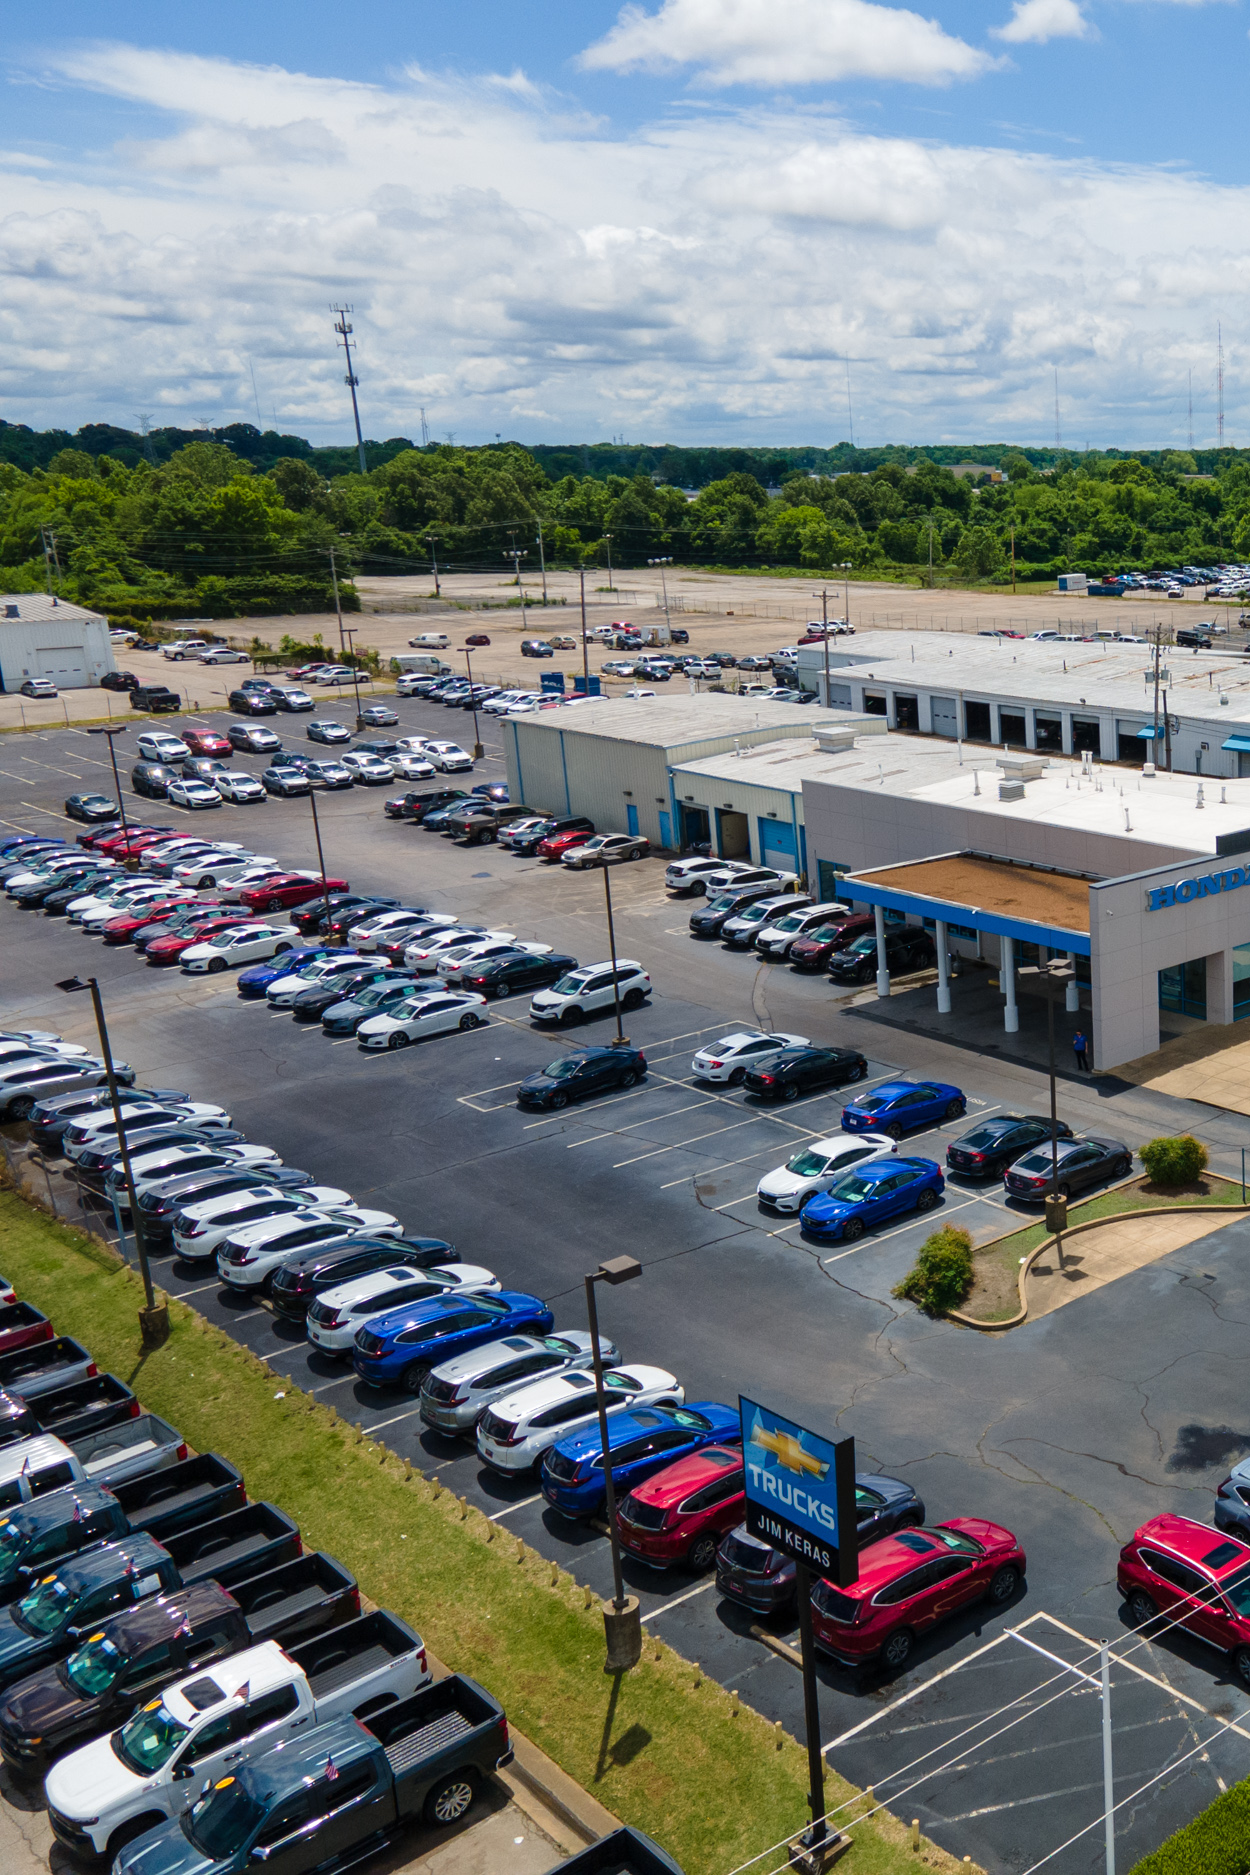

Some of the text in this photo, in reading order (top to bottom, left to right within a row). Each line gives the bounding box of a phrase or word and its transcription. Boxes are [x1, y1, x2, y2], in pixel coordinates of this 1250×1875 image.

[748, 1462, 836, 1531] TRUCKS
[757, 1514, 831, 1568] JIM KERAS
